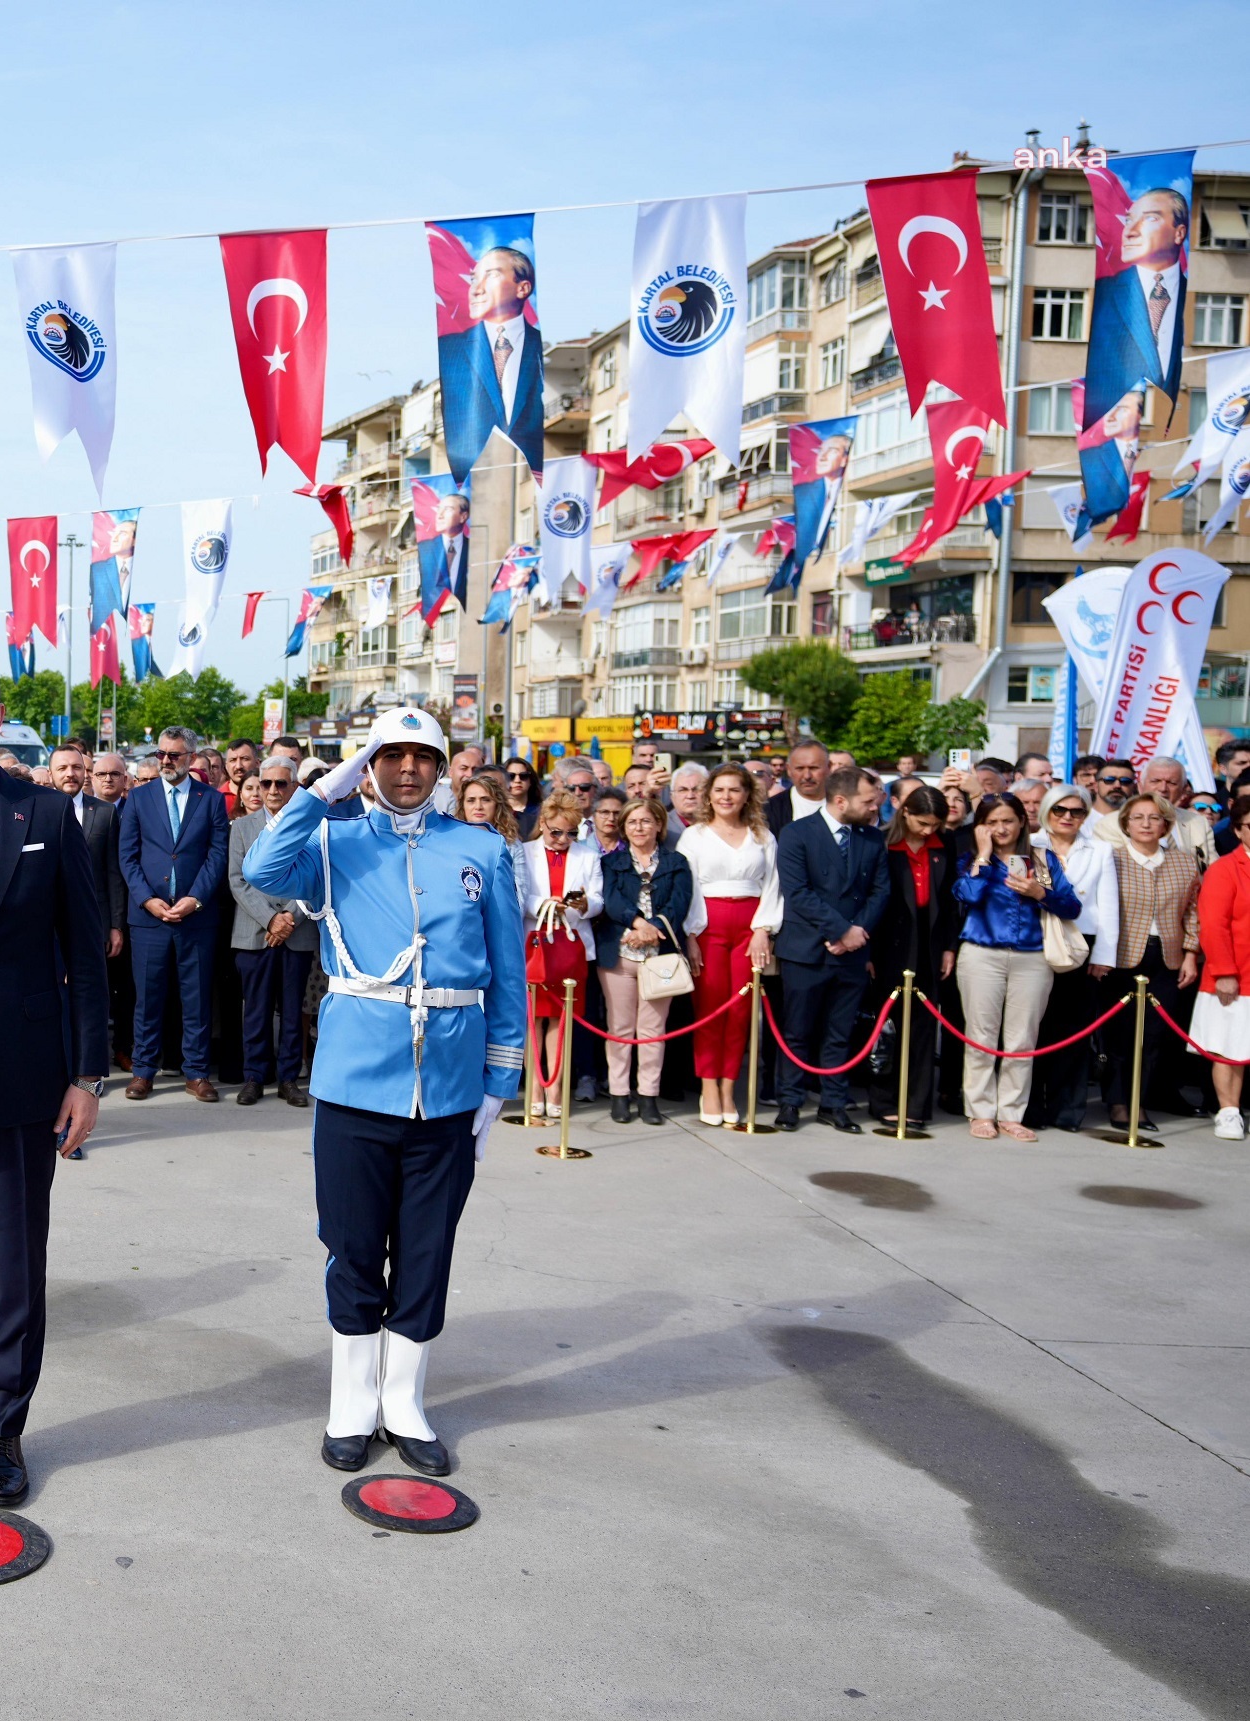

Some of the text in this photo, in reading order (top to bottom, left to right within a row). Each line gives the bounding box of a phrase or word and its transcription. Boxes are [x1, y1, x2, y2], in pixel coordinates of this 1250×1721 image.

[637, 264, 738, 314] KARTAL BELEDİYESİ
[26, 299, 108, 349] KARTAL BELEDİYESİ
[1114, 644, 1148, 725] PARTİSİ
